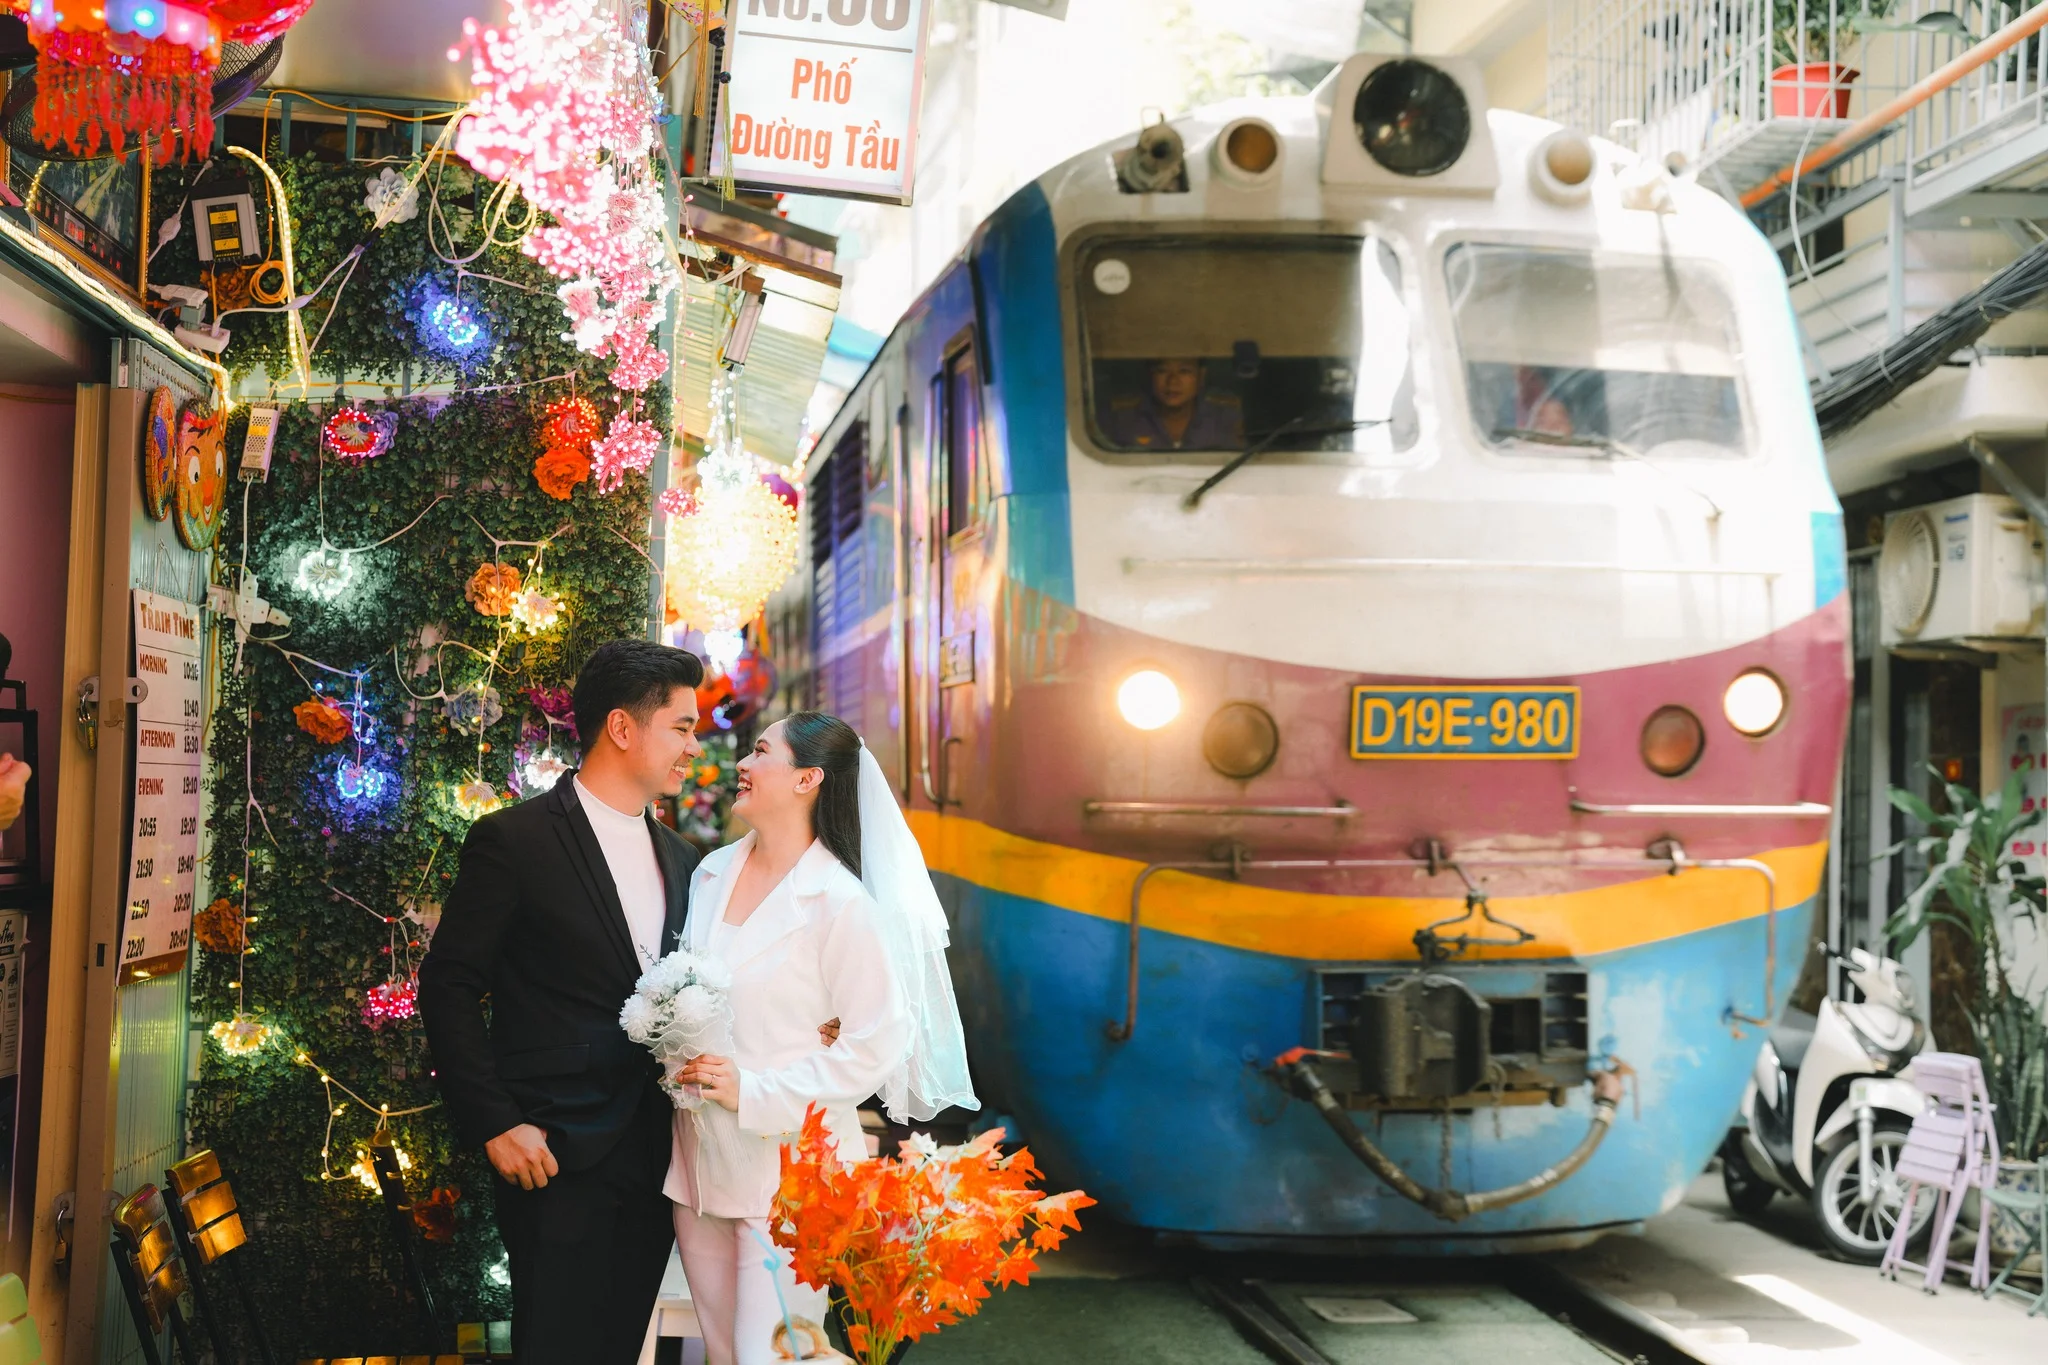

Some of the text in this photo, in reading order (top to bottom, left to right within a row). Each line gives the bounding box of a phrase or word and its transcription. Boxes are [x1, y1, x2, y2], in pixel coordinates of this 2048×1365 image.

[790, 57, 858, 105] Phố
[731, 113, 900, 172] Đường Tầu
[140, 602, 195, 640] TRAIN TIME
[139, 652, 168, 675] MORNING
[184, 698, 199, 718] 11:40
[1361, 697, 1570, 747] D19E-980
[140, 728, 176, 748] AFTERNOON
[184, 735, 199, 754] 15:30
[138, 777, 164, 796] EVENING
[182, 775, 198, 794] 19:10
[138, 817, 157, 837] 20:55
[180, 816, 197, 836] 19:20
[135, 857, 154, 879] 21:30
[177, 854, 195, 874] 19:40
[173, 892, 191, 913] 20:20
[125, 936, 145, 960] 22:20
[168, 928, 188, 950] 20:40
